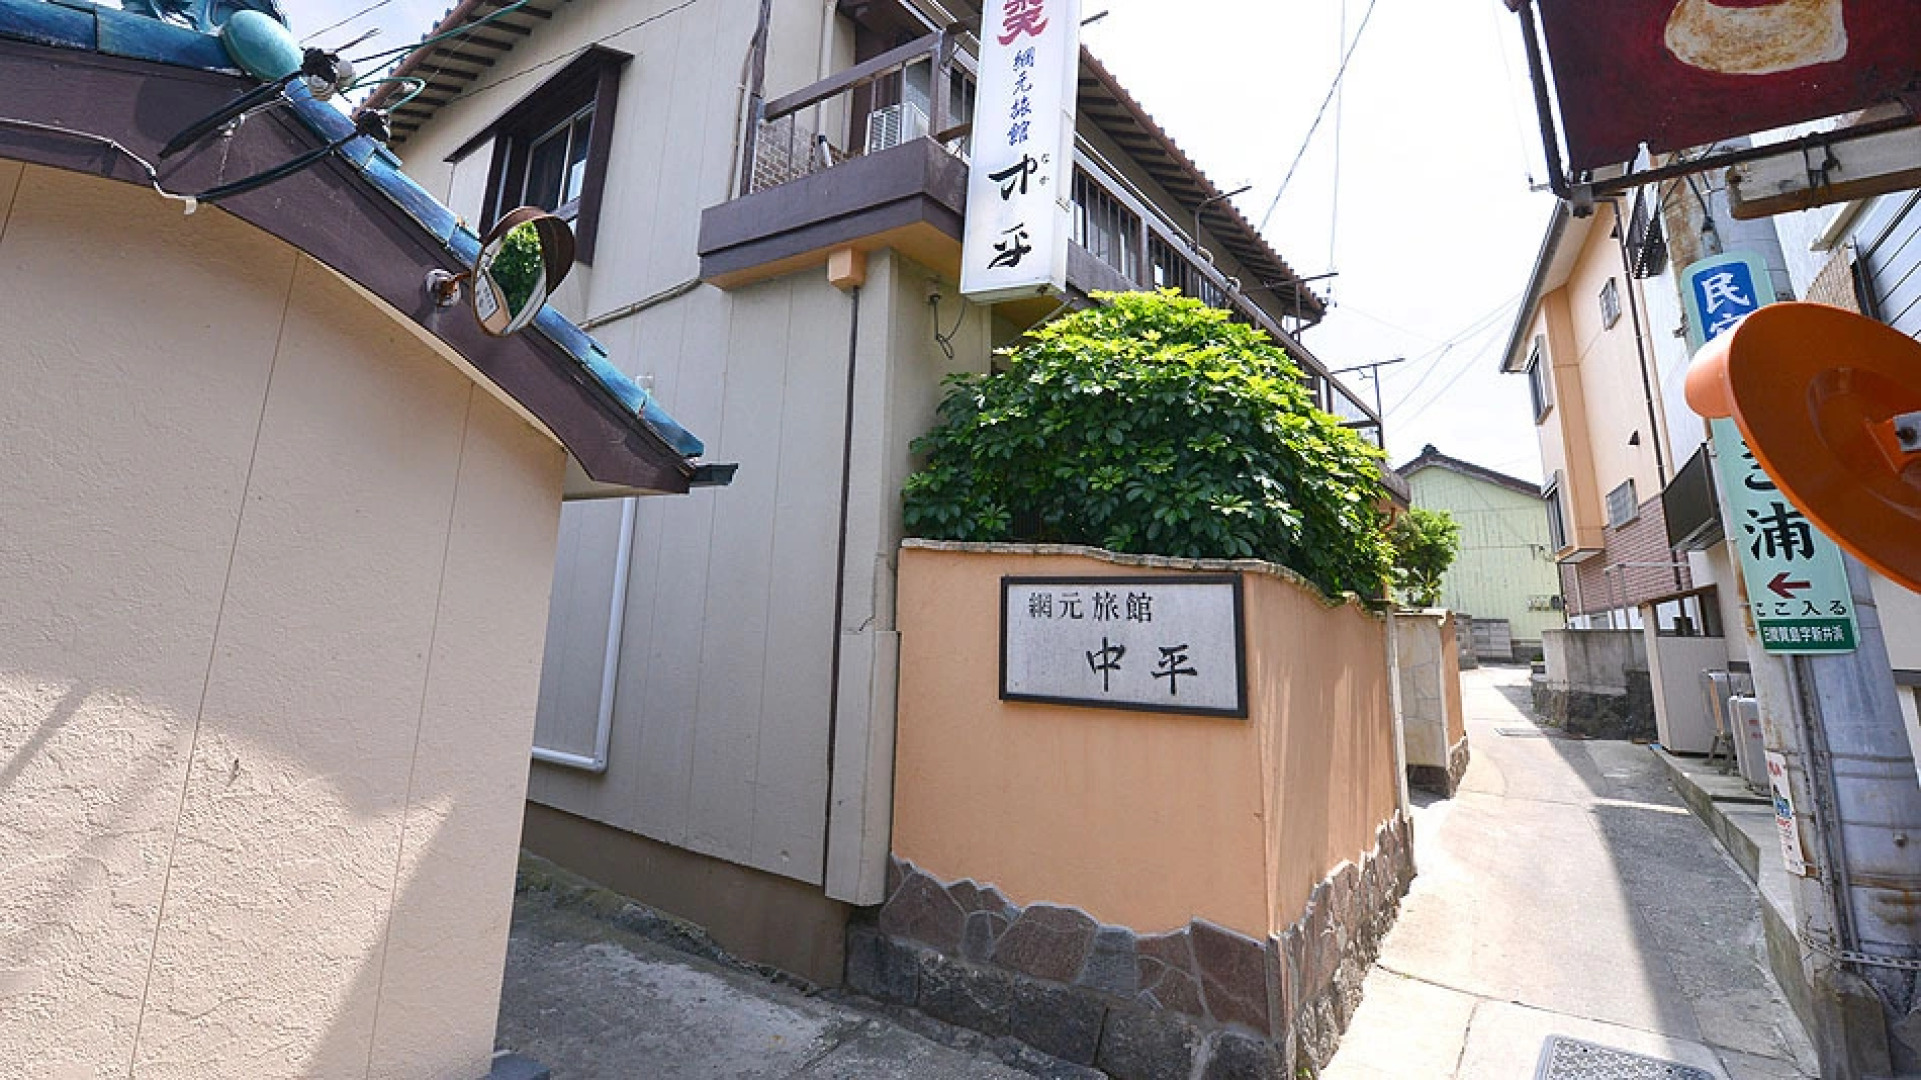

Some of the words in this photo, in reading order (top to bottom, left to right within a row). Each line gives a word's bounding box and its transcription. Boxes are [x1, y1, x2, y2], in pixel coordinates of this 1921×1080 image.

[1006, 46, 1036, 146] 網元旅館
[1028, 590, 1153, 623] 網元旅館
[1756, 600, 1847, 615] ここ入る
[1085, 636, 1198, 696] 中平
